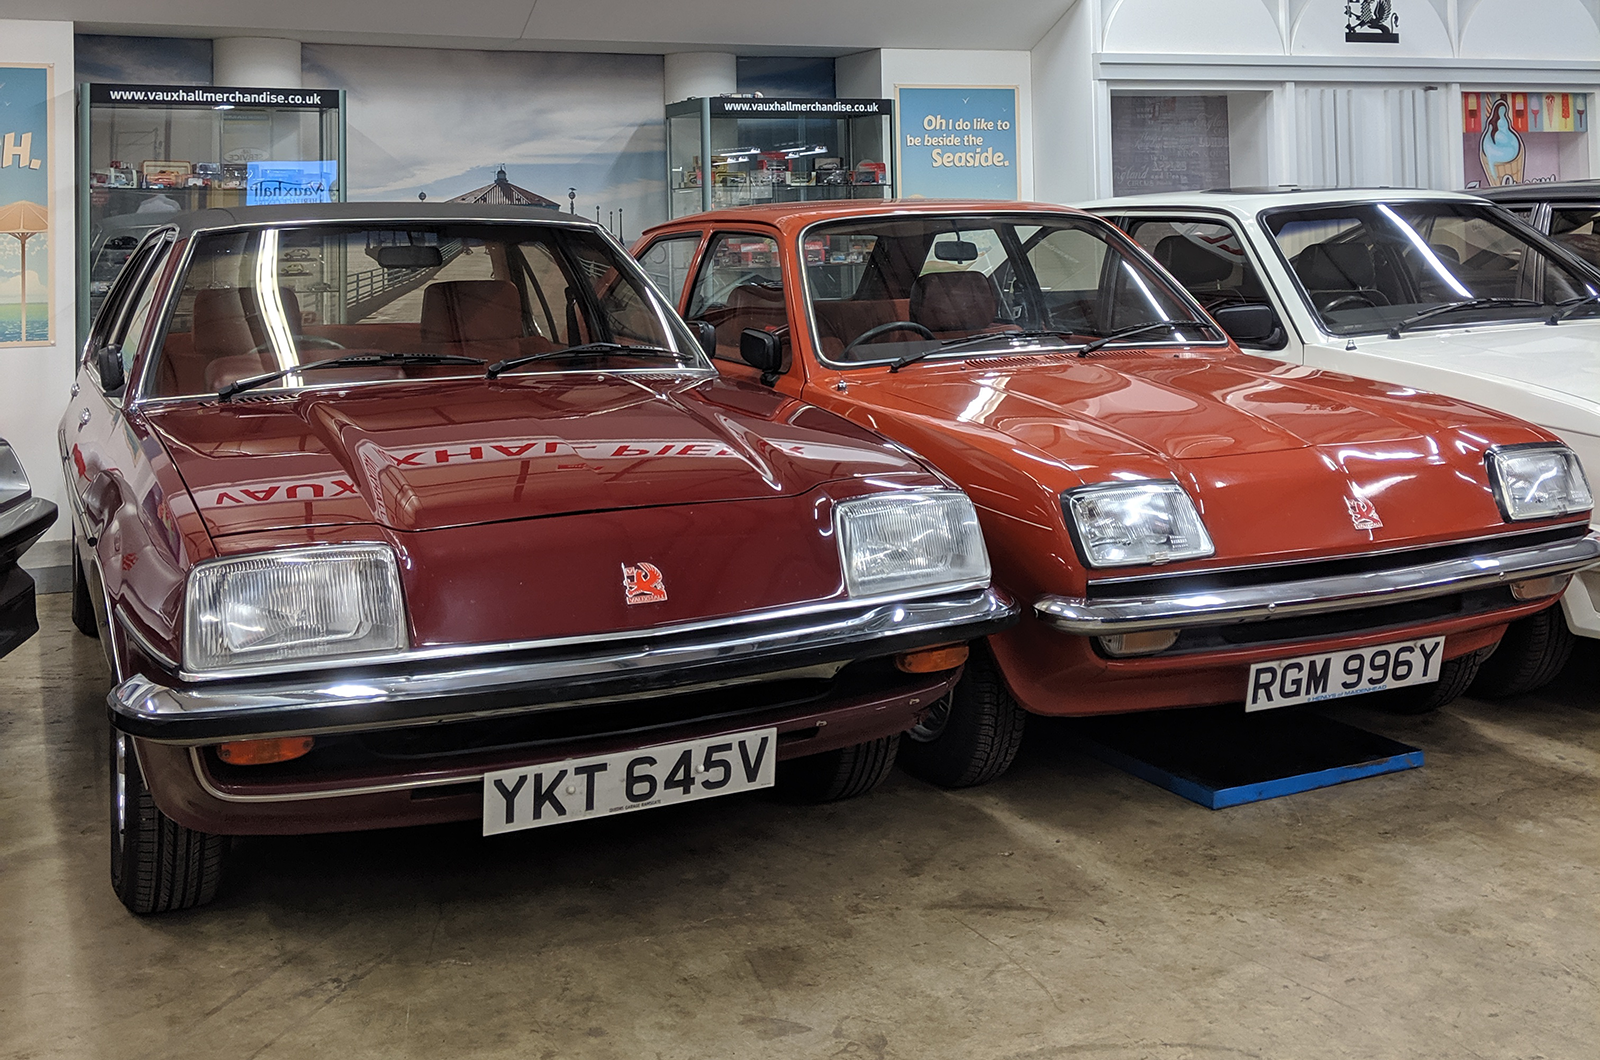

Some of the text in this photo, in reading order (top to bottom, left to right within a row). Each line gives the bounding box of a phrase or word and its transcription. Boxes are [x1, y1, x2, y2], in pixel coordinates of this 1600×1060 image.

[109, 88, 322, 105] www.vauxhallmerchandise.co.uk
[724, 100, 879, 113] www.vauxhallmerchandise.co.uk
[923, 114, 1011, 131] Oh I do like to
[906, 134, 983, 146] be beside the
[0, 131, 42, 170] H.
[931, 147, 1010, 168] Seaside.
[629, 594, 665, 603] VAUXHALL
[1251, 641, 1441, 705] RGM 996Y
[493, 736, 769, 824] YKT 645V
